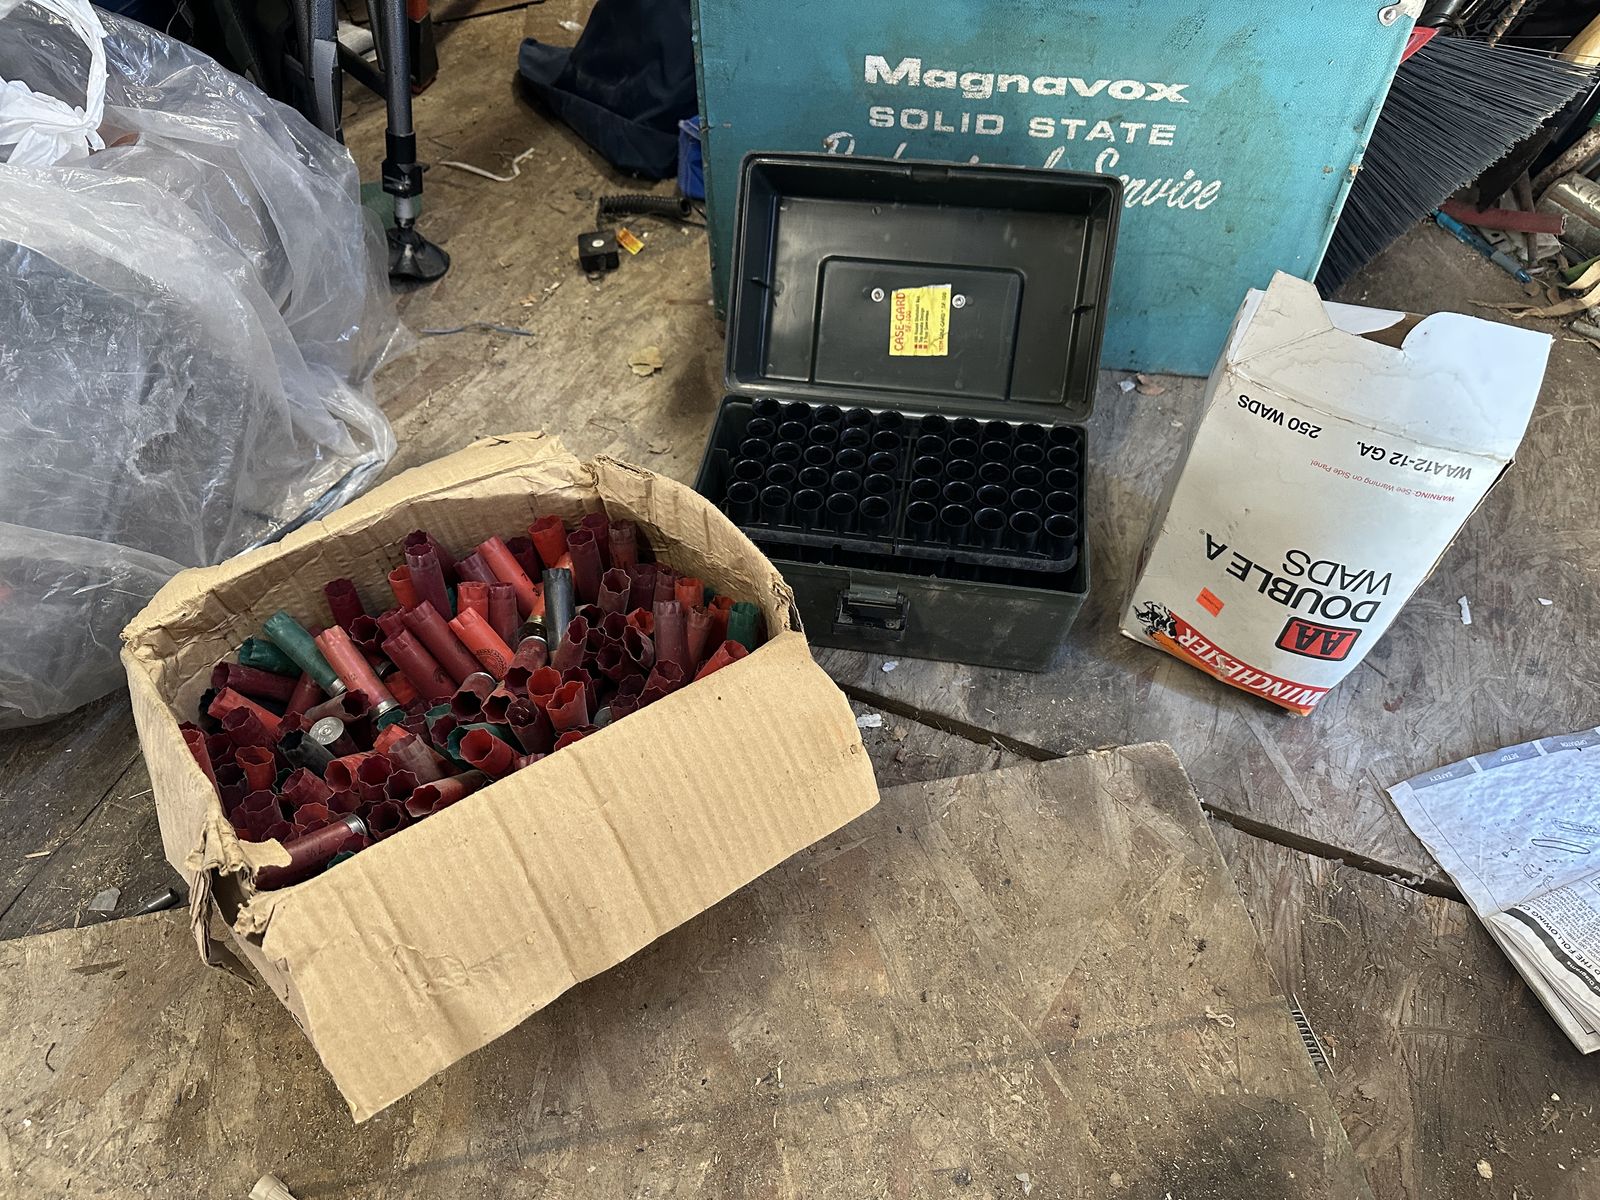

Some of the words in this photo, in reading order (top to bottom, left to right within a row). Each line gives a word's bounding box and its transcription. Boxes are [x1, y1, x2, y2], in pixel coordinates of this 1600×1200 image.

[864, 54, 1190, 104] Magnavox
[868, 106, 1005, 135] SOLID
[1028, 117, 1177, 146] STATE
[894, 292, 905, 351] CASE-GARD
[1238, 394, 1285, 426] WADS
[1288, 418, 1322, 438] 250
[1356, 441, 1386, 461] GA.
[1389, 452, 1472, 480] WAA12-12
[1333, 468, 1350, 479] Side
[1364, 478, 1394, 492] Warning
[1396, 486, 1412, 496] See
[1206, 532, 1228, 561] A
[1225, 551, 1382, 623] DOUBLE
[1282, 549, 1392, 596] WADS
[1178, 627, 1327, 706] WINCHESTER
[1531, 911, 1576, 955] FOLLOWING
[1575, 954, 1592, 969] THE
